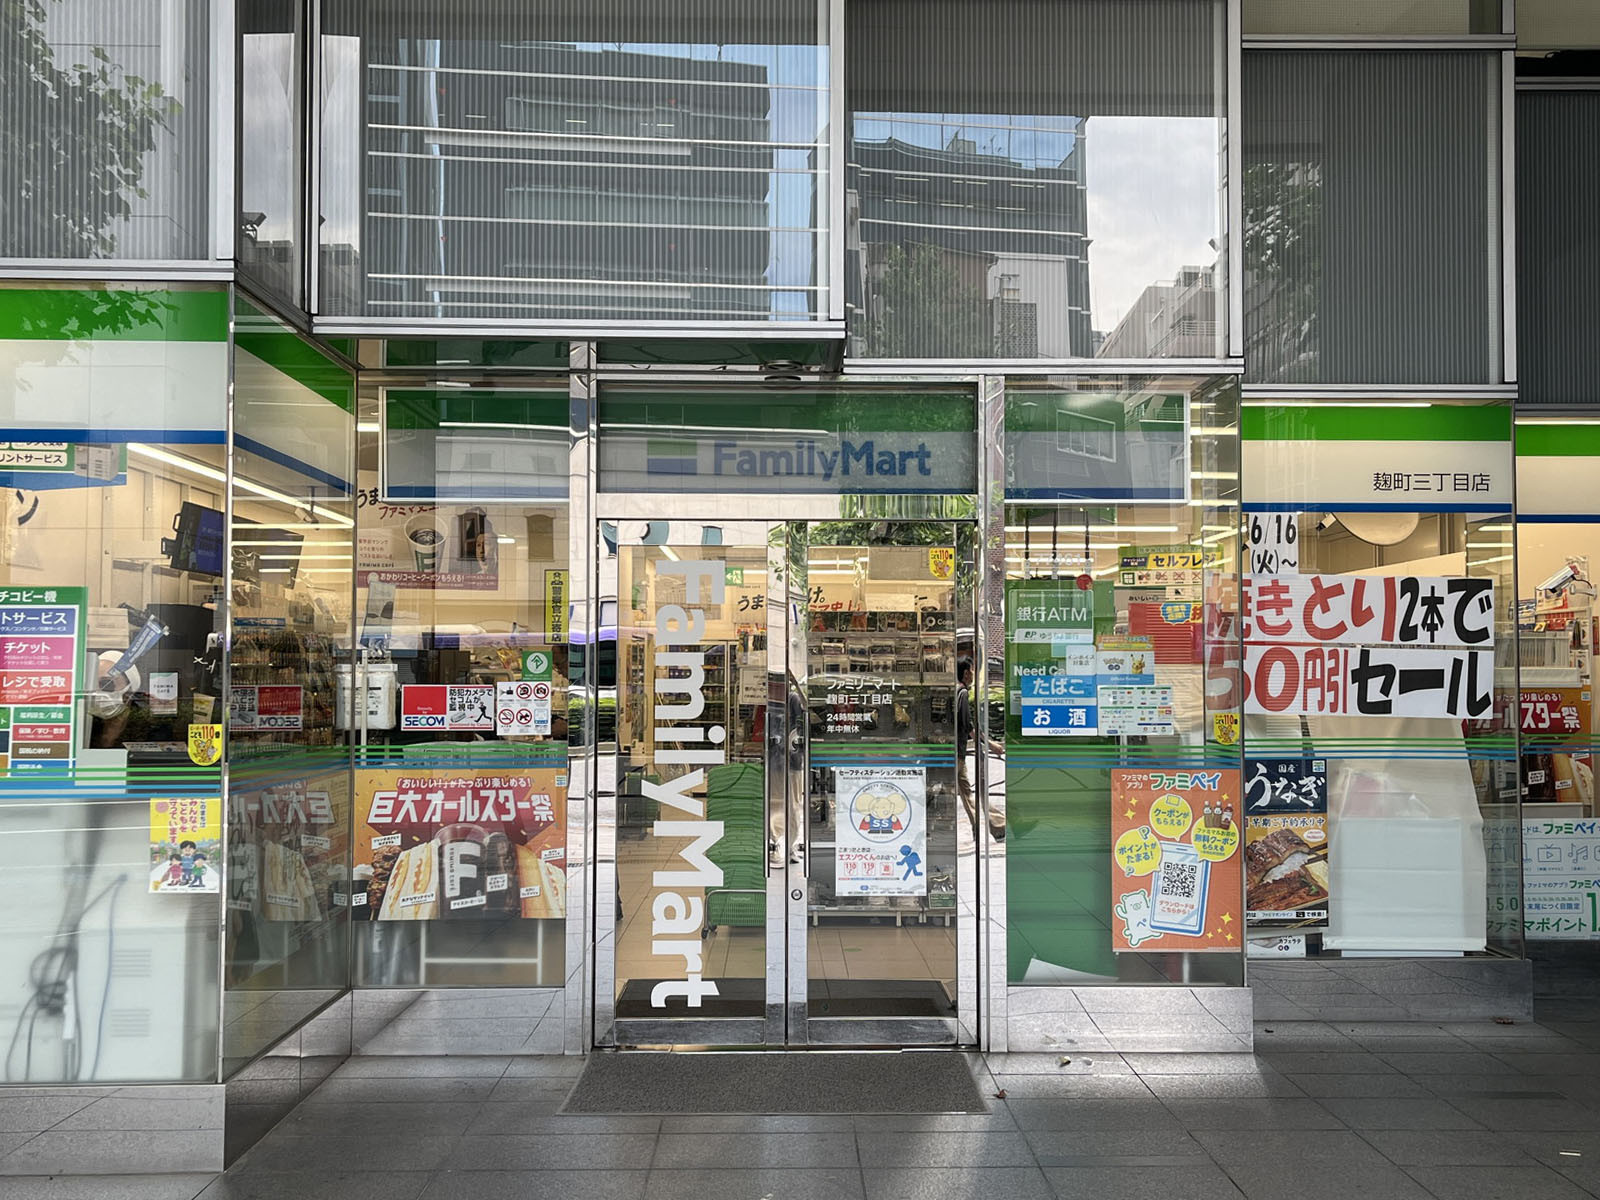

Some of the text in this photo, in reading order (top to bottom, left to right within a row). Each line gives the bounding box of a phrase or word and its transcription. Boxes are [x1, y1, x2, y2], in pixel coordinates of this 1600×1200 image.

[713, 440, 932, 481] FamilyMart
[1372, 472, 1491, 493] 麹町三丁目店
[1251, 514, 1297, 545] 6/16
[1016, 606, 1087, 622] 銀行ATM
[4, 641, 51, 654] チケット
[1014, 665, 1046, 676] Need
[3, 676, 66, 687] レジで受取
[1033, 678, 1085, 695] たばこ
[449, 688, 492, 696] 防犯カメラで
[404, 716, 445, 726] SECOM
[641, 560, 725, 1008] FamilyMart
[1149, 772, 1222, 791] ファミペイ
[1245, 762, 1326, 811] うなぎ
[367, 789, 555, 823] 巨大オールスター祭
[1542, 822, 1597, 835] ファミペイ
